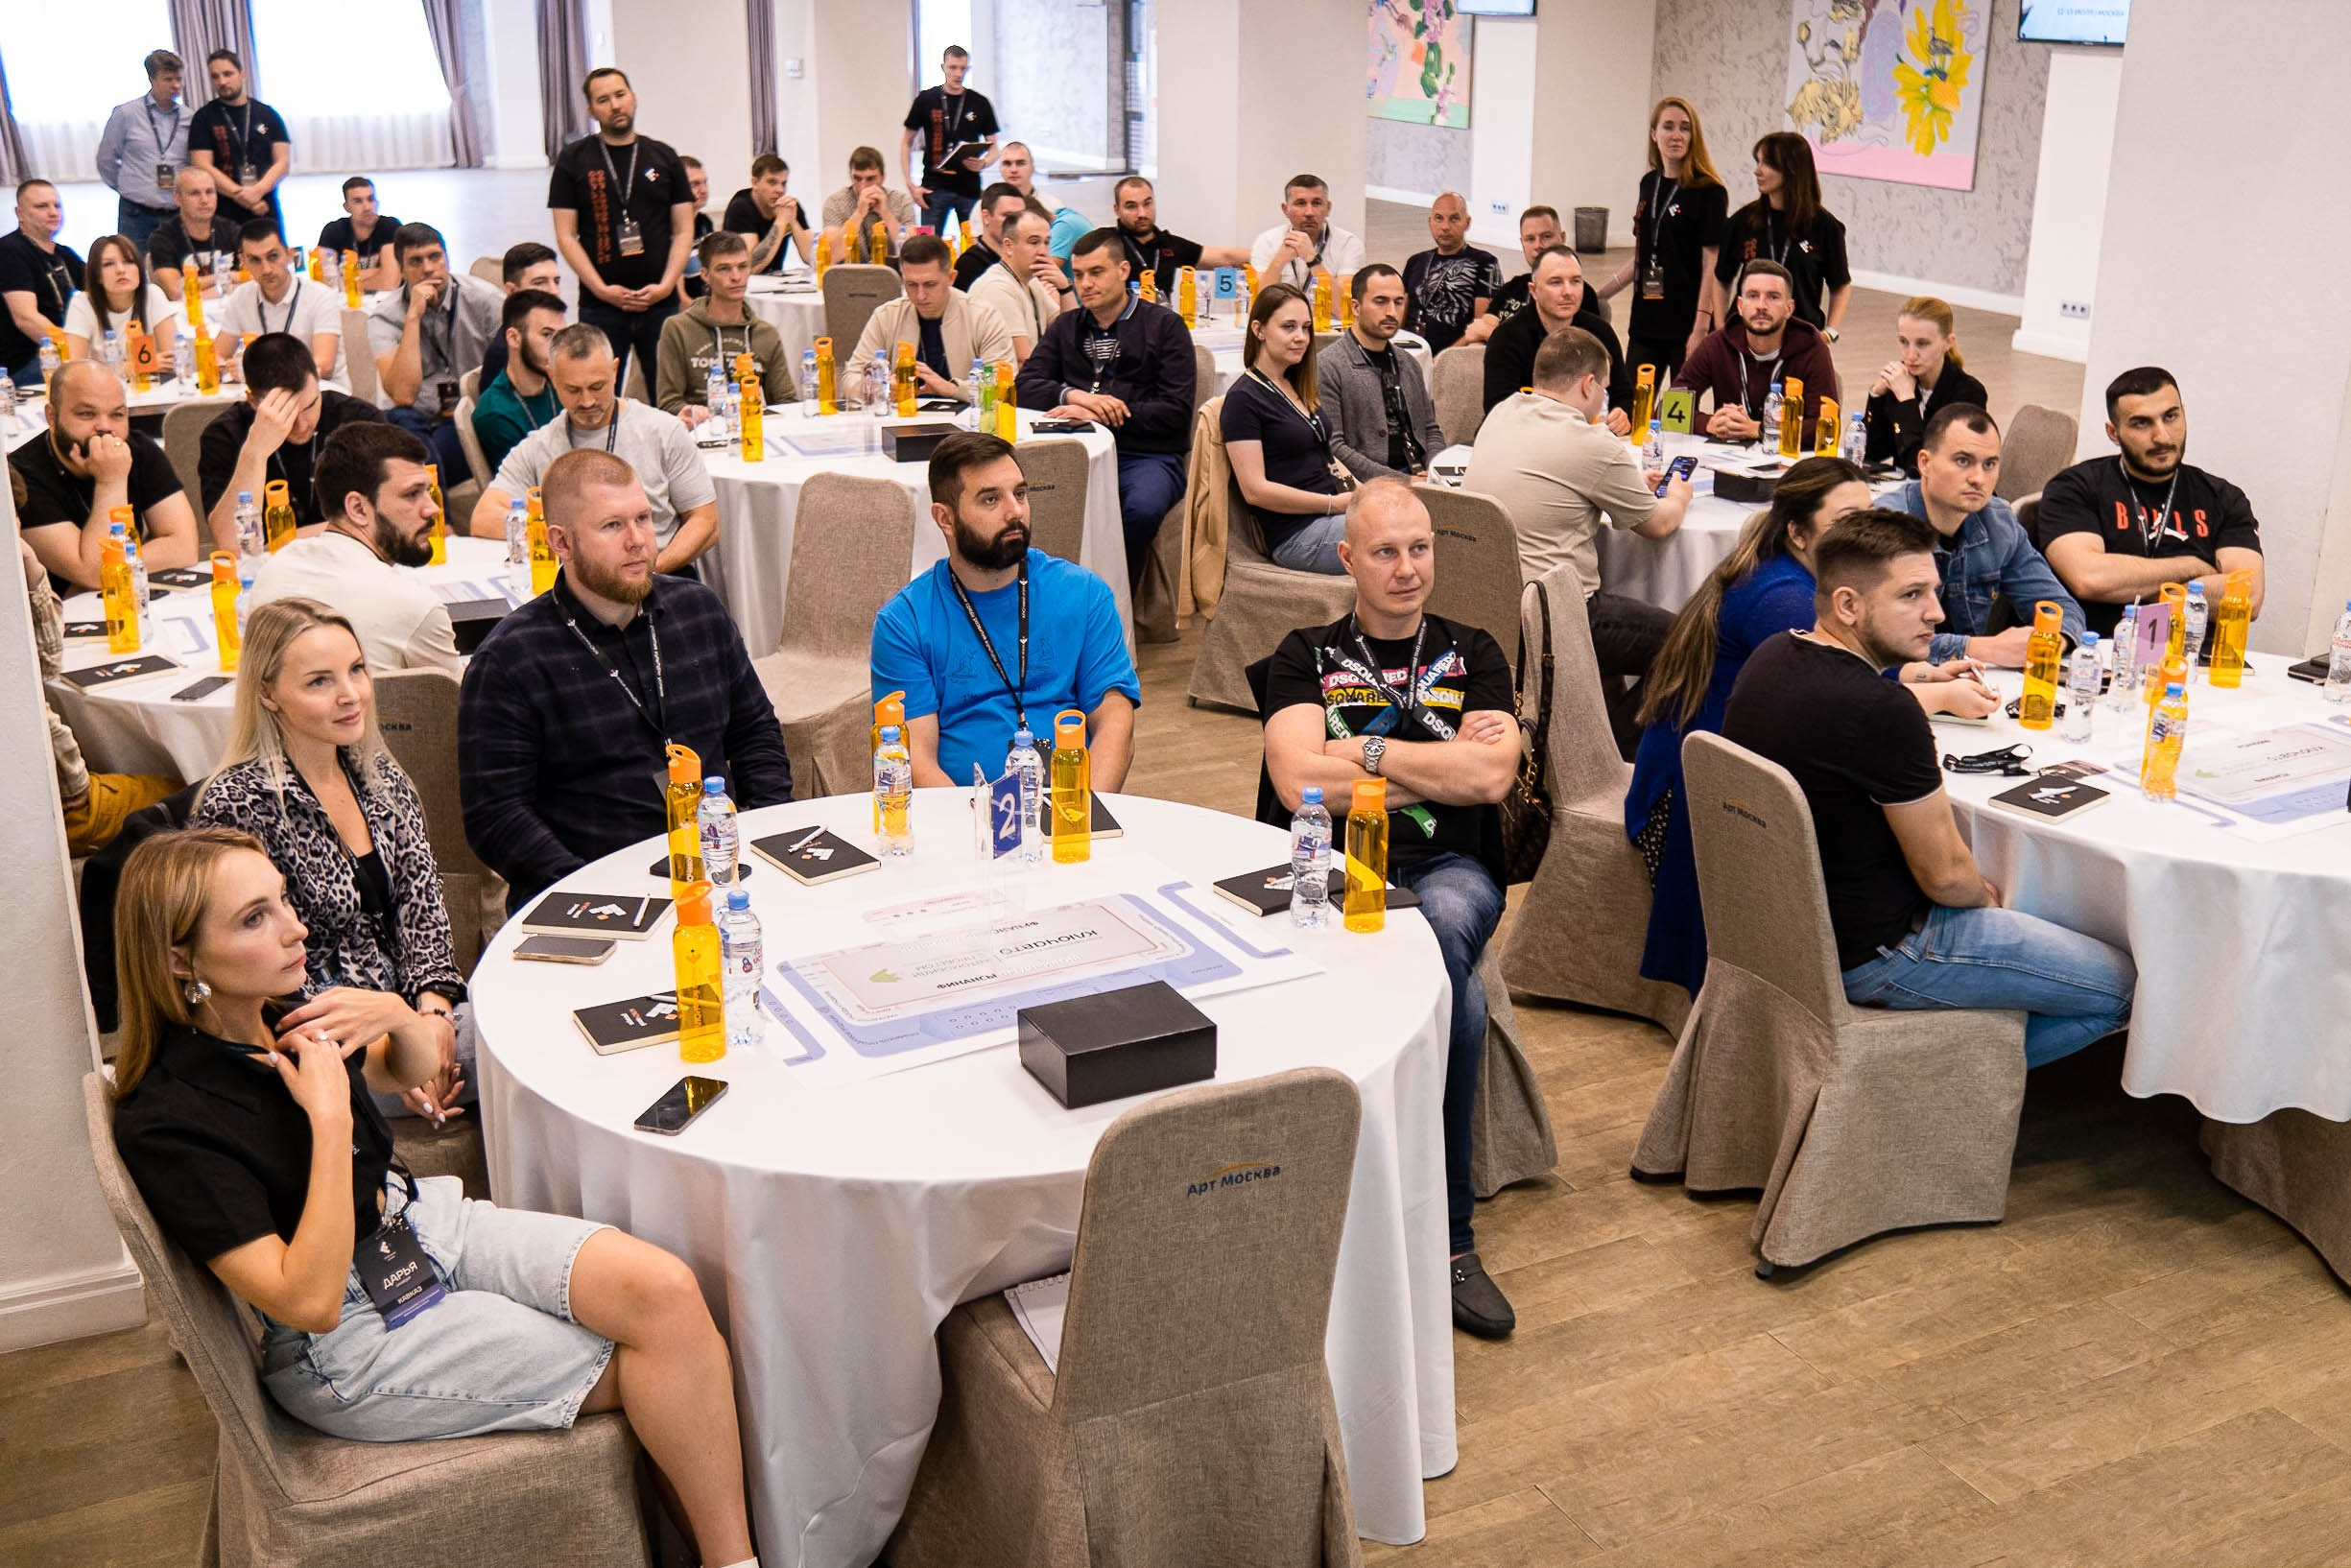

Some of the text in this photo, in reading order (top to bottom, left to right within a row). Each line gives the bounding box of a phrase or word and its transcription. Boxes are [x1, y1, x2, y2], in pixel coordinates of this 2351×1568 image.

[1220, 274, 1232, 293] 5
[138, 344, 152, 365] 6
[1667, 400, 1686, 424] 4
[2148, 618, 2158, 651] 1
[999, 793, 1015, 840] 2
[937, 972, 998, 989] ФИНАНСЫ
[1187, 1166, 1281, 1198] Арт Москва
[383, 1261, 418, 1291] ДАРЬЯ
[397, 1285, 423, 1304] КАВКАЗ
